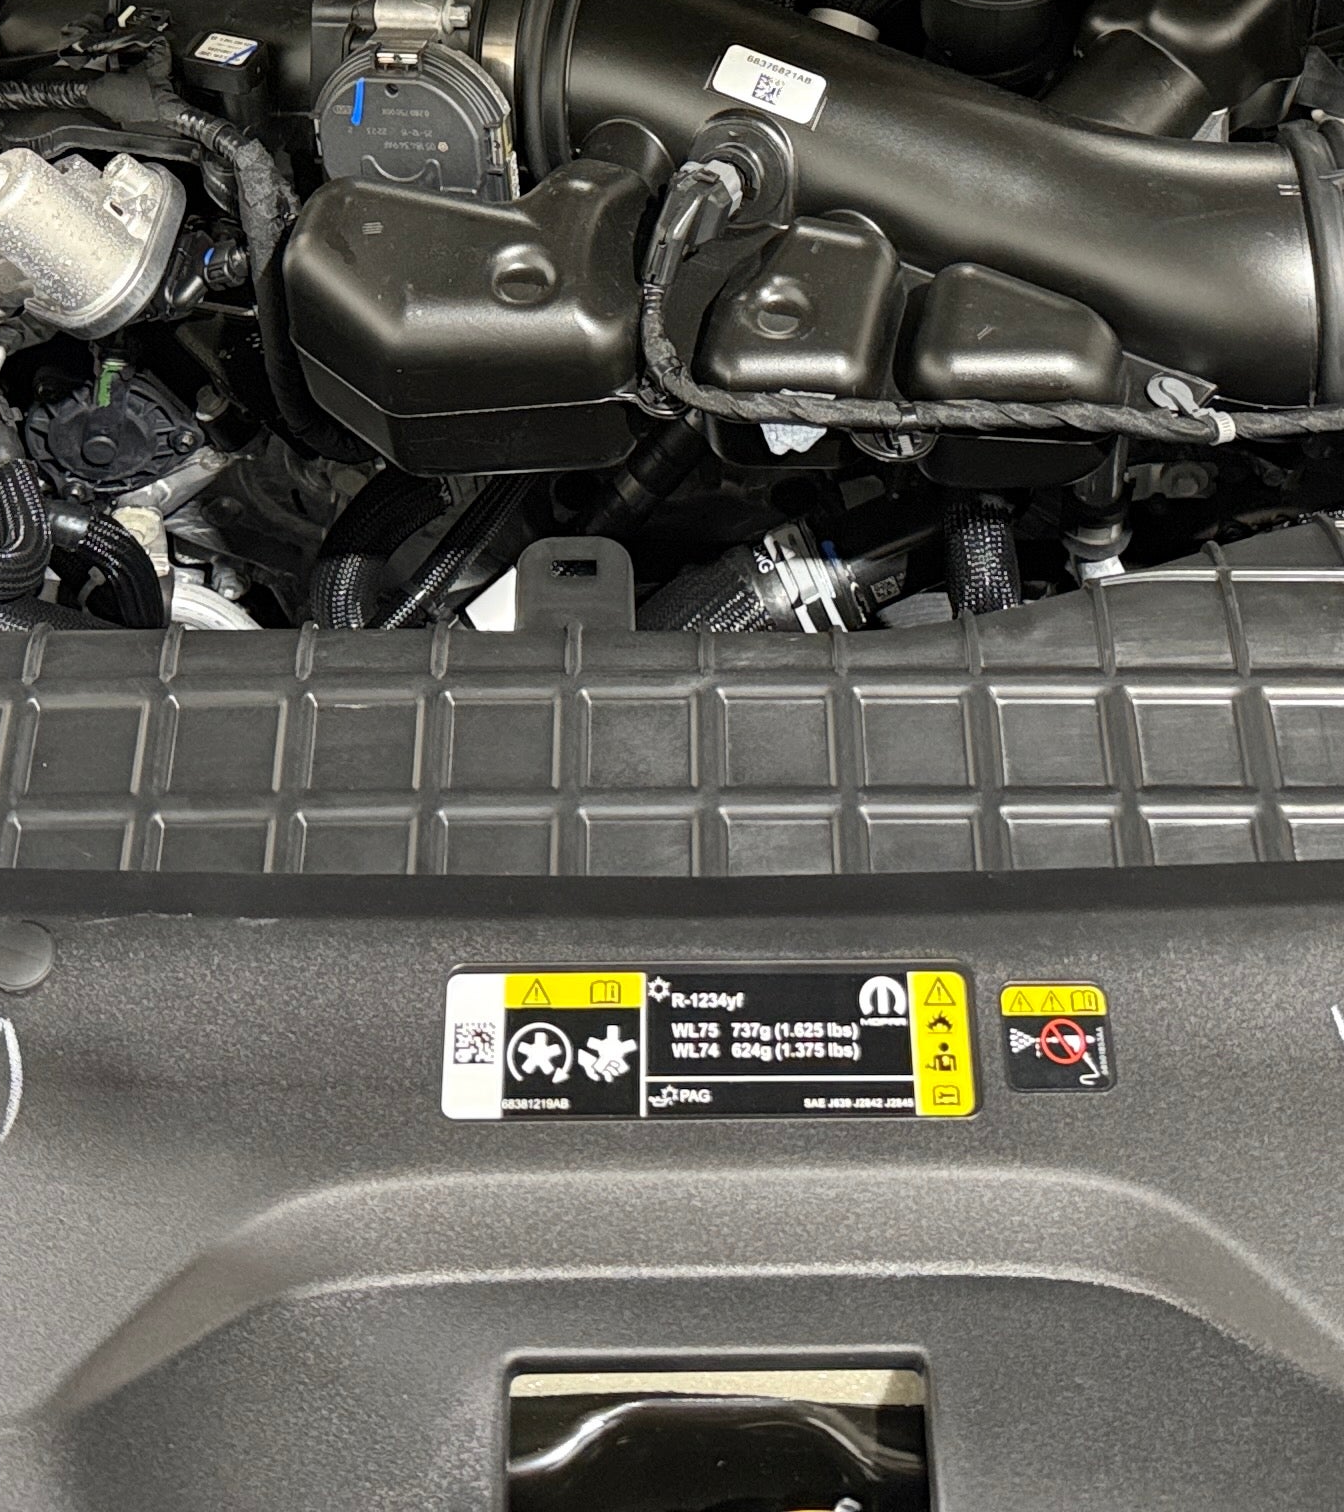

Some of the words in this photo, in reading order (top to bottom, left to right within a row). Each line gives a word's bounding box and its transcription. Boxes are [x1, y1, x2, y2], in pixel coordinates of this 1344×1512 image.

[746, 54, 813, 85] 68376821AB
[671, 992, 745, 1012] R-1234yf
[859, 1017, 907, 1027] MOPAR
[671, 1022, 721, 1039] WL75
[730, 1022, 772, 1041] 737g
[774, 1022, 825, 1041] (1.625
[827, 1022, 861, 1041] lbs)
[671, 1042, 721, 1059] WL74
[731, 1042, 773, 1062] 624g
[775, 1042, 826, 1062] (1.375
[827, 1042, 862, 1062] lbs)
[501, 1097, 571, 1110] 68381219AB
[679, 1088, 713, 1103] PAG
[803, 1097, 827, 1109] SAE
[827, 1097, 852, 1109] J639
[852, 1097, 883, 1109] J2842
[884, 1097, 914, 1109] J2845
